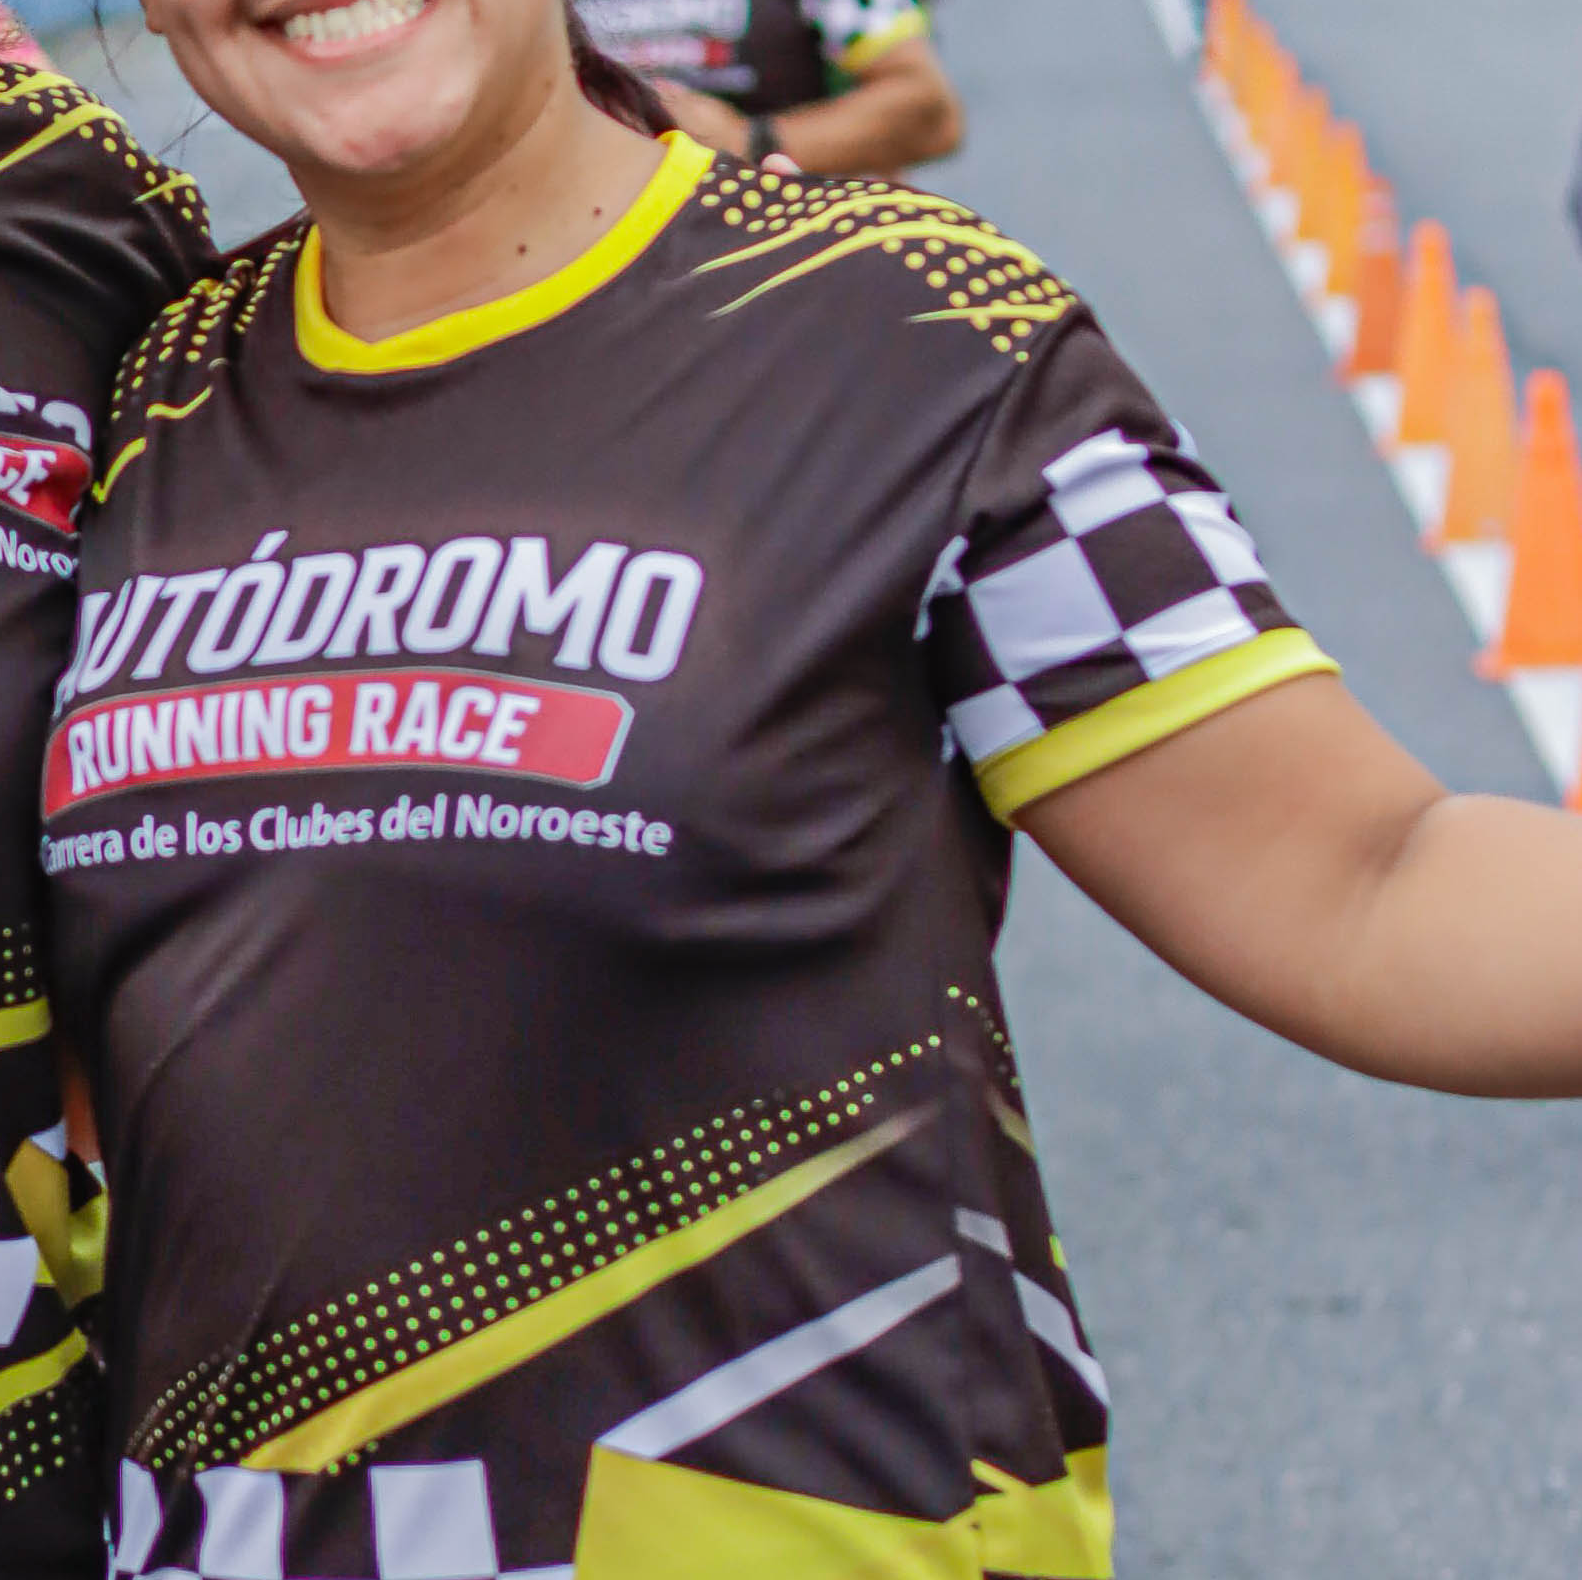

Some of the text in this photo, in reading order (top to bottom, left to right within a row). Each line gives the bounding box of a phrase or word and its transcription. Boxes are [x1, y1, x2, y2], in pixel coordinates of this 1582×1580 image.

[68, 681, 541, 795] RUNNING RACE
[130, 814, 178, 860] de
[185, 810, 243, 855] los
[249, 803, 374, 851] Clubes
[379, 793, 447, 841] del
[454, 793, 673, 855] Noroeste
